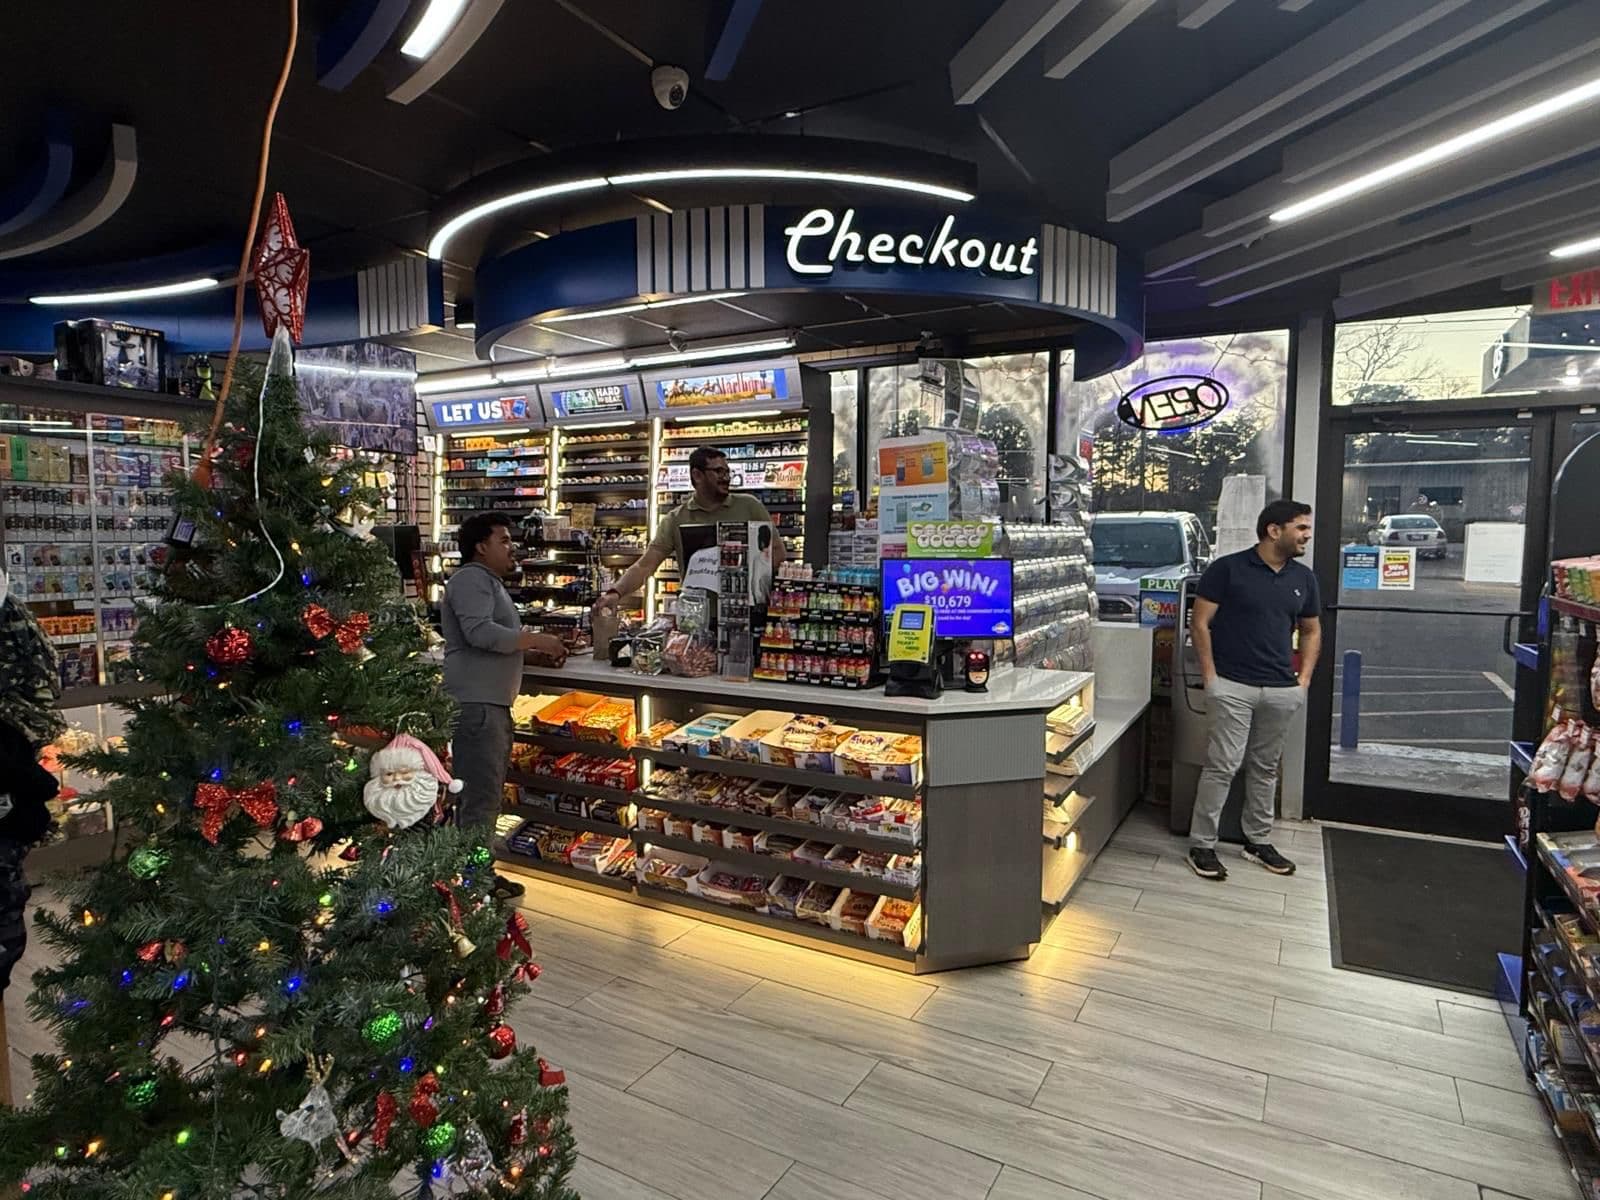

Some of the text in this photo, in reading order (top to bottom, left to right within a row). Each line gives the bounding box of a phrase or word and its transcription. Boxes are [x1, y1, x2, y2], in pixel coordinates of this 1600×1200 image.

[784, 208, 1038, 275] Checkout
[595, 386, 621, 397] HARD
[442, 401, 504, 423] LET US
[896, 569, 998, 598] BIG WIN!
[1147, 579, 1178, 589] PLAY
[924, 595, 971, 609] $10,679
